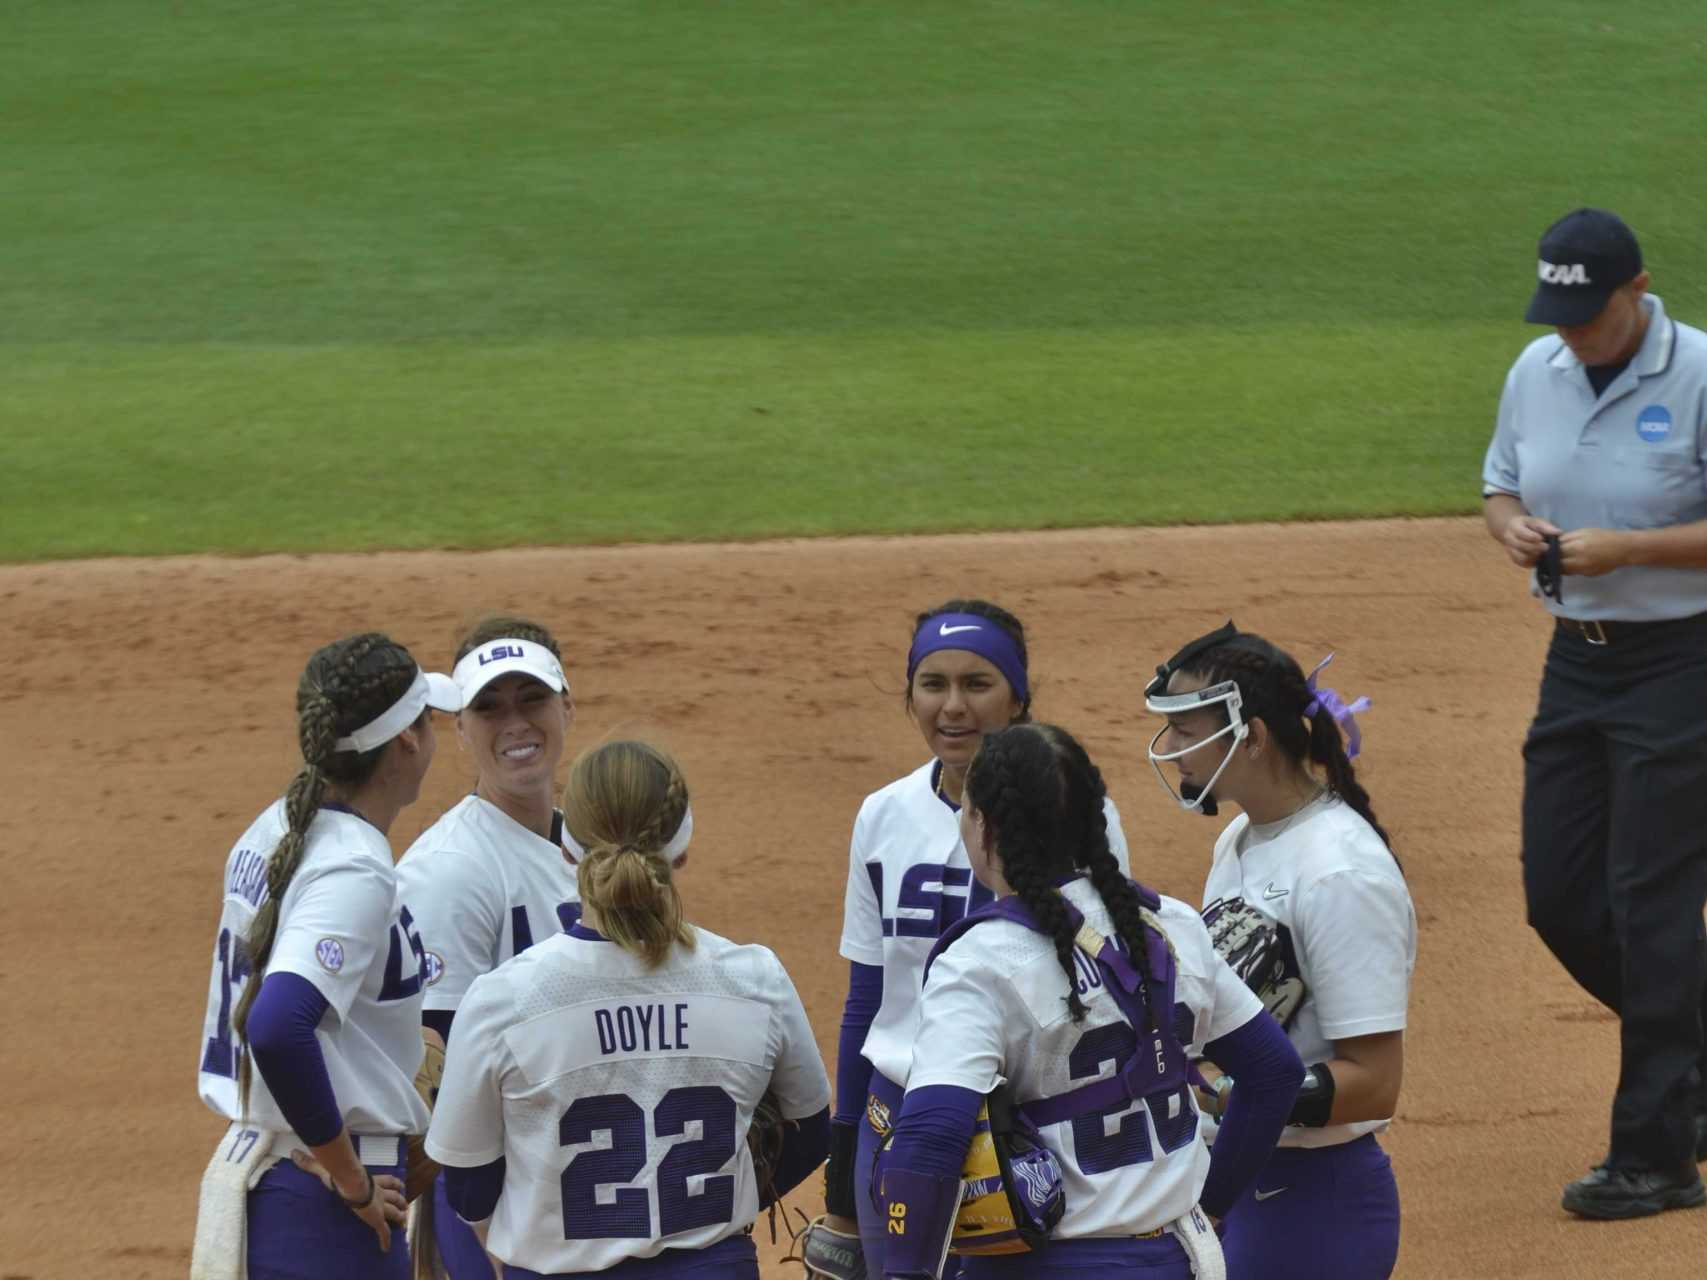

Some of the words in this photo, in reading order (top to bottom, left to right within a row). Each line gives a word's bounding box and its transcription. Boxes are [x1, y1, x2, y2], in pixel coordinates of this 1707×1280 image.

[479, 646, 523, 665] LSU
[595, 1003, 689, 1055] DOYLE
[226, 1129, 259, 1164] 17
[559, 1086, 737, 1240] 22
[888, 1202, 907, 1235] 26
